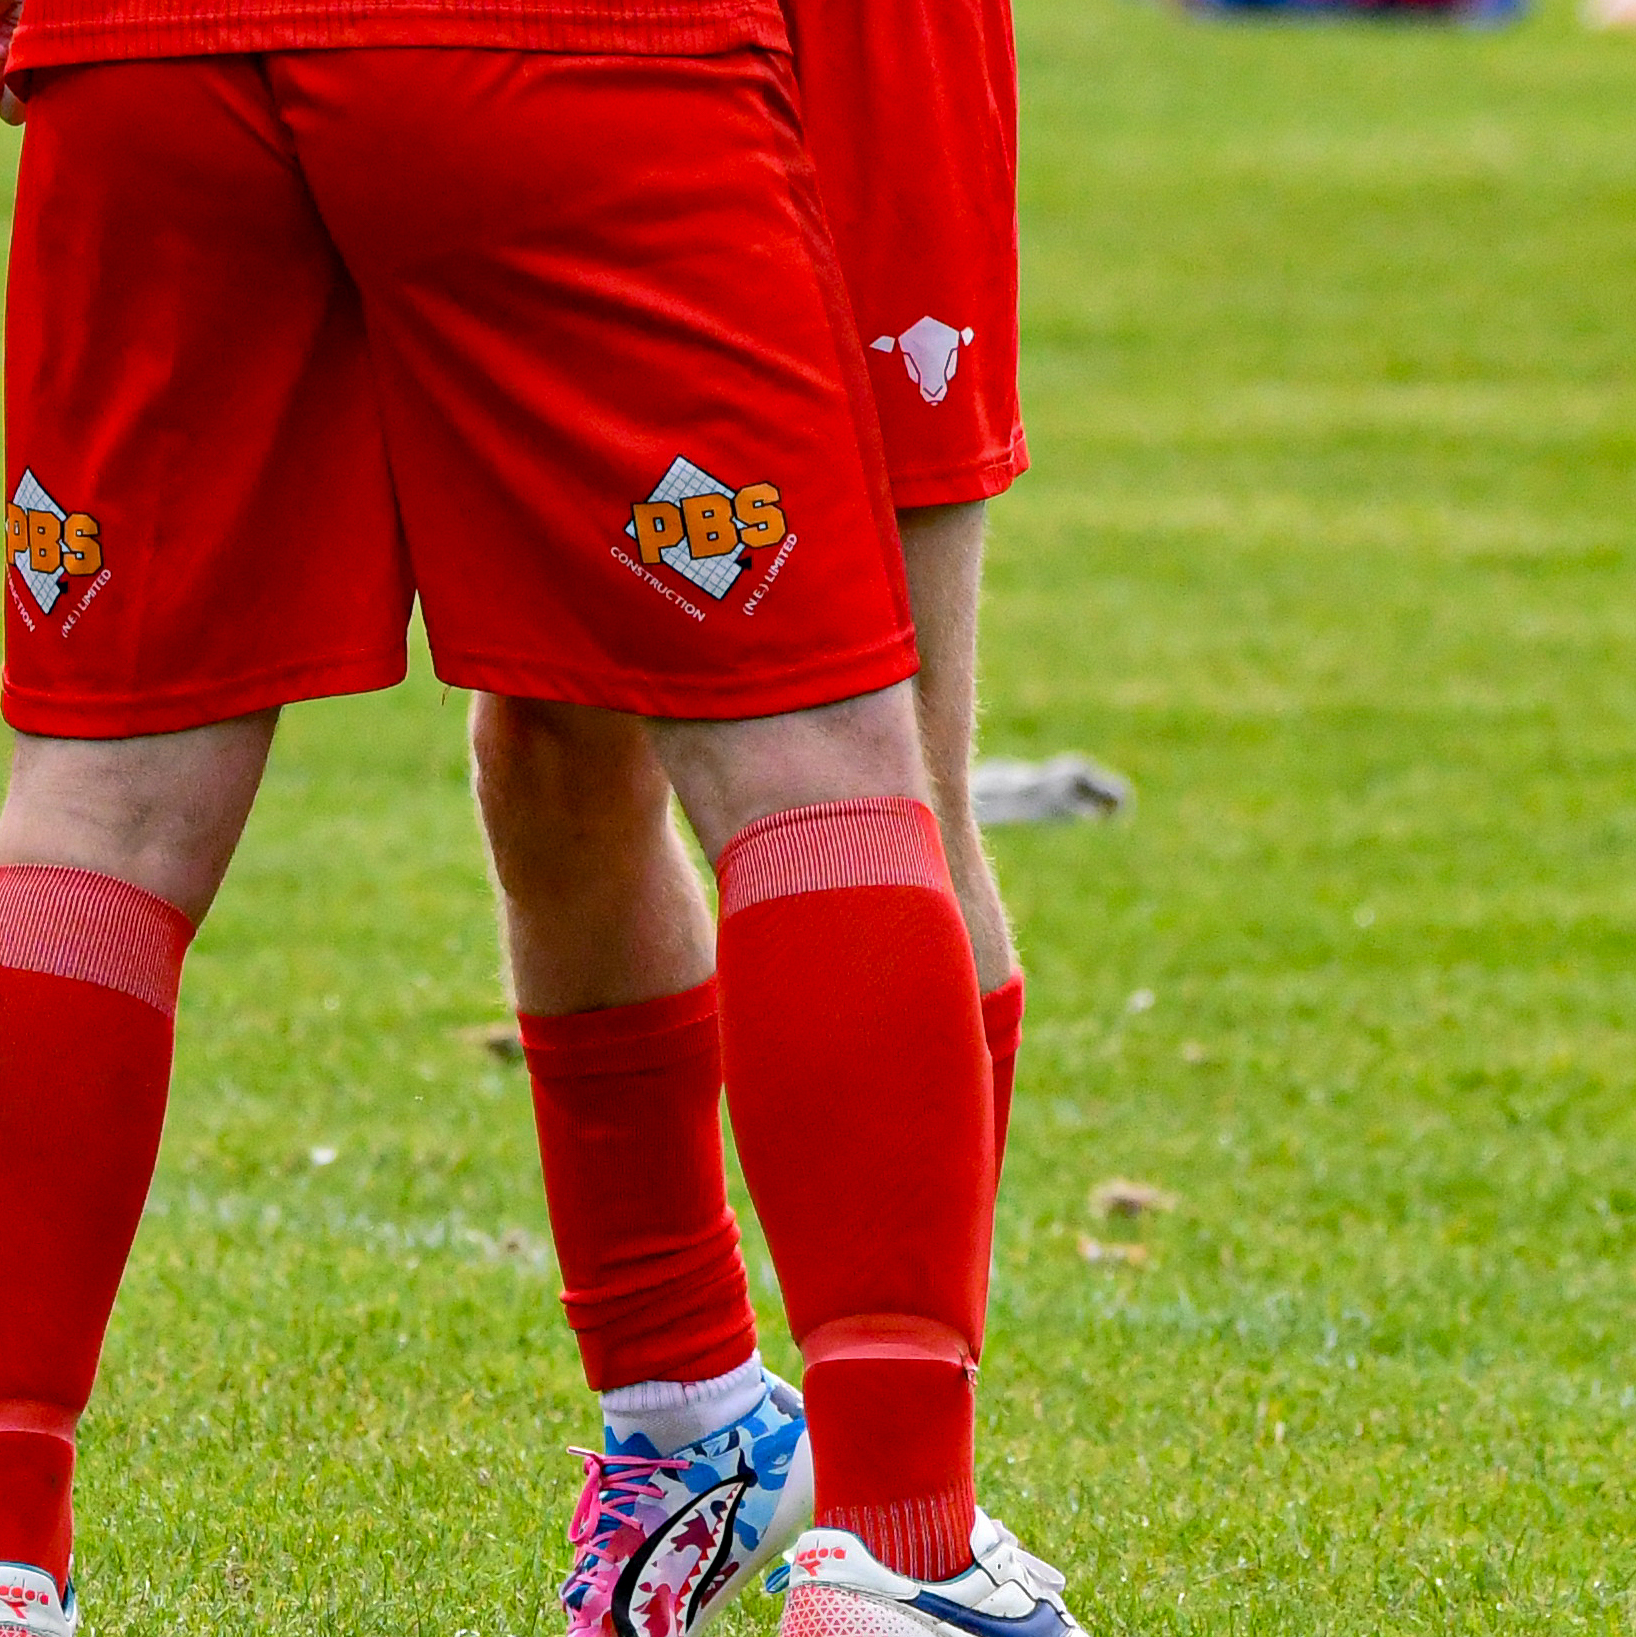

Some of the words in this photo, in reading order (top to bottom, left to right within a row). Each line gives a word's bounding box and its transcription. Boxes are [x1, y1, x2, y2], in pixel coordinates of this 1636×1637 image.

[6, 501, 104, 576] PBS
[631, 480, 788, 564] PBS
[765, 532, 799, 583] LIMITED
[77, 567, 113, 612] LIMITED
[610, 545, 706, 622] CONSTRUCTION
